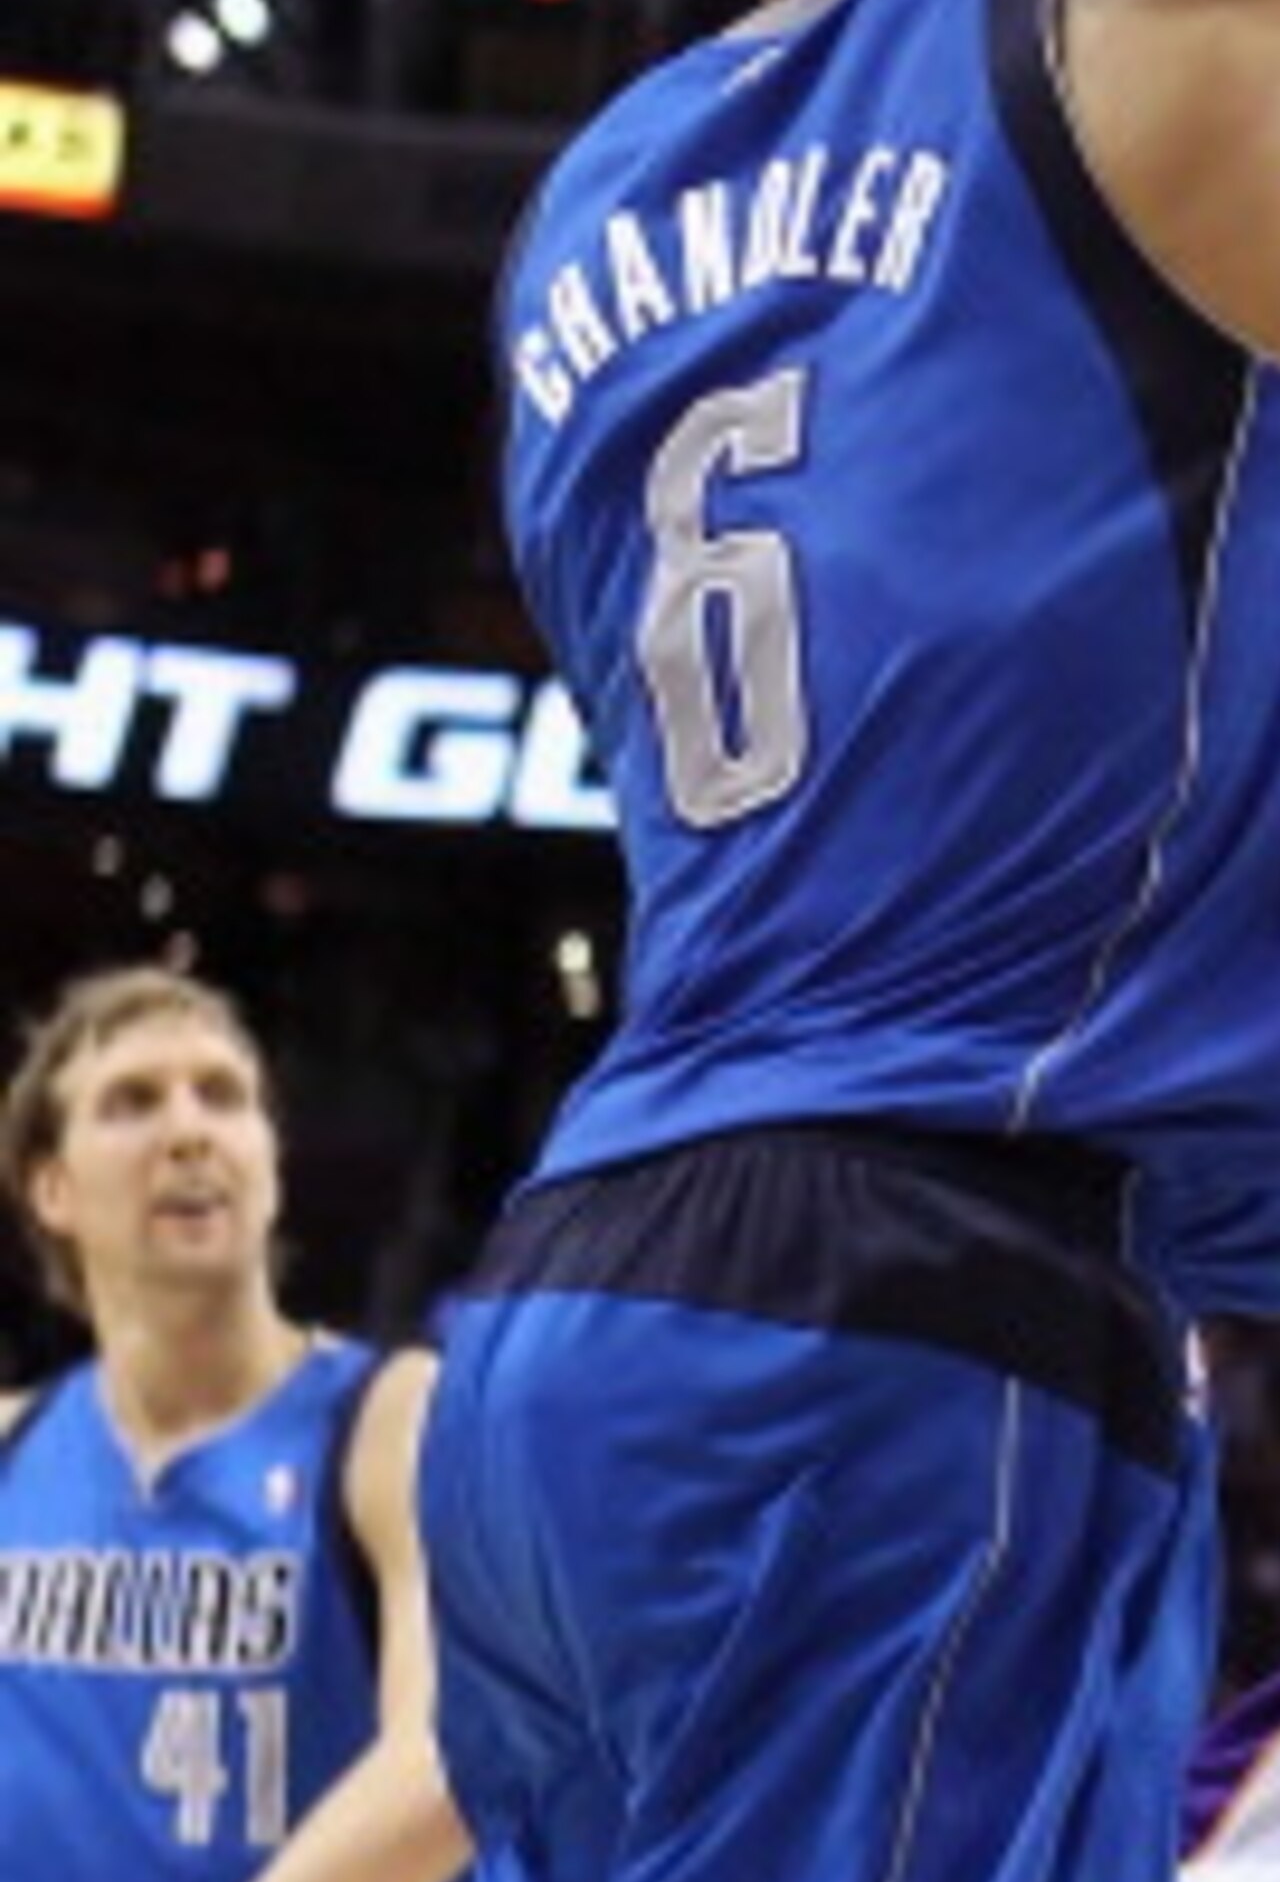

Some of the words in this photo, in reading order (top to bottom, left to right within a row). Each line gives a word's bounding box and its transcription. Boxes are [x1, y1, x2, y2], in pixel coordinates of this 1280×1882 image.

[511, 140, 947, 428] CHANDLER
[636, 363, 808, 830] 6
[139, 1686, 288, 1848] 41
